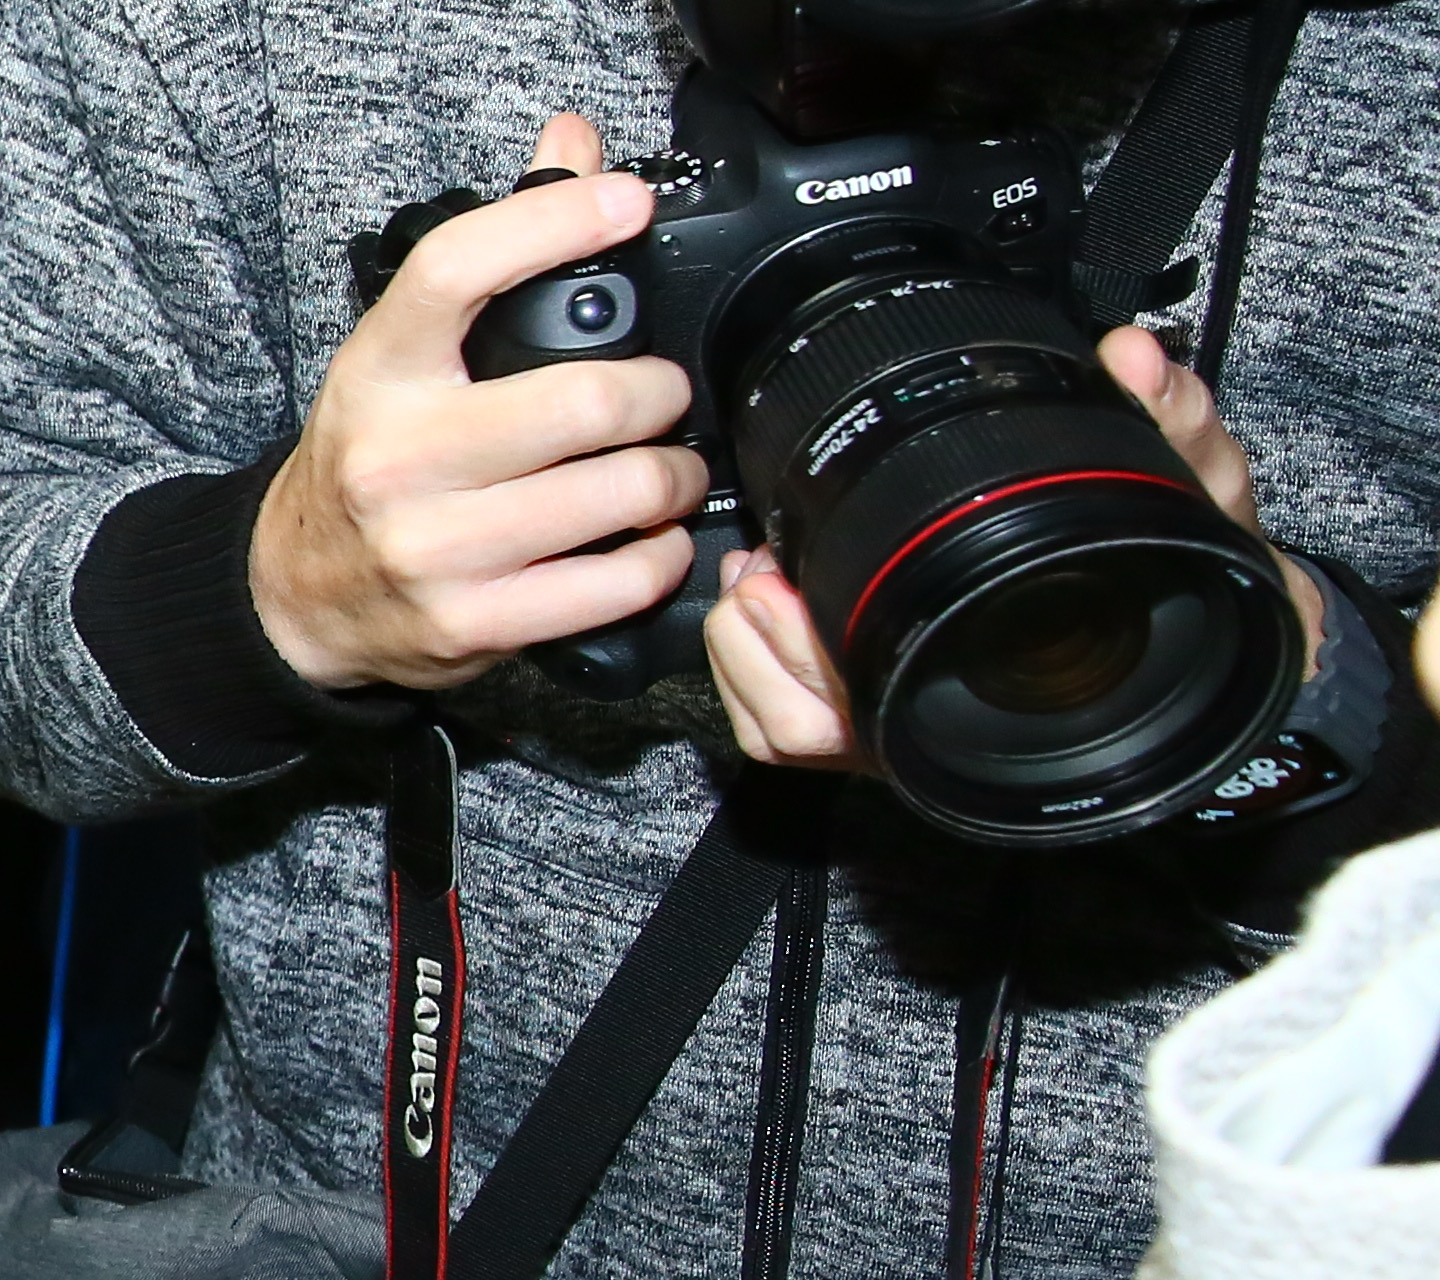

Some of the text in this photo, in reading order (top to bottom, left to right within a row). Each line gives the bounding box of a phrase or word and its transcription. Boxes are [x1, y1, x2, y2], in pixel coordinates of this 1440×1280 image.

[794, 164, 914, 206] Canon
[992, 177, 1038, 210] EOS
[807, 407, 884, 476] 24-70mm
[808, 398, 873, 457] ULTRASONIC
[404, 956, 443, 1159] Canon
